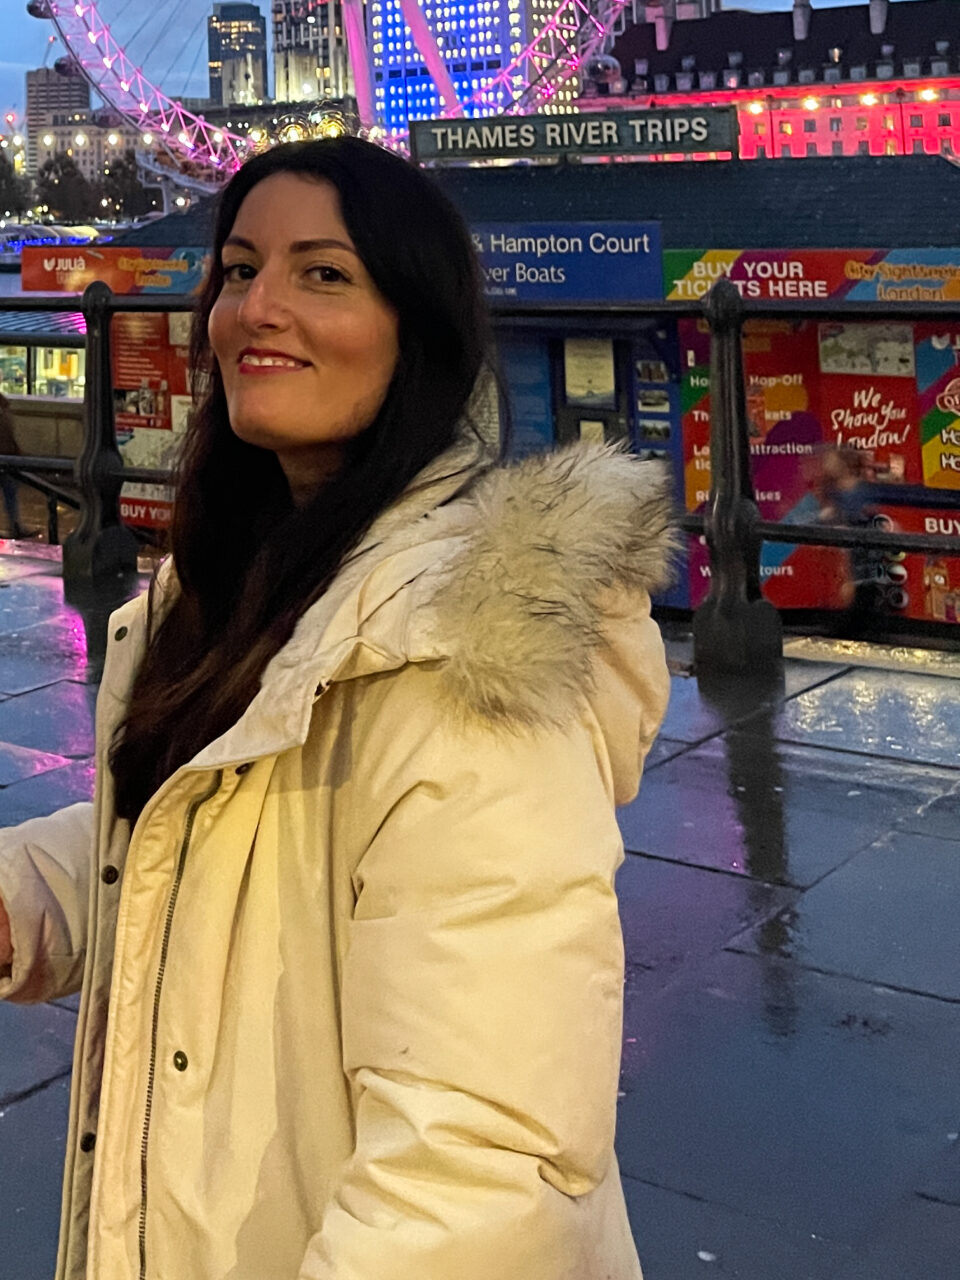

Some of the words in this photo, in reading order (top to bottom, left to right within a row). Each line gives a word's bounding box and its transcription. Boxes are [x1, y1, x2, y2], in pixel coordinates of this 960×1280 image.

[432, 124, 535, 149] THAMES
[546, 121, 618, 147] RIVER
[629, 117, 708, 143] TRIPS
[490, 233, 583, 257] Hampton
[590, 232, 650, 253] Court
[482, 267, 510, 282] ver
[516, 263, 565, 283] Boats
[693, 261, 734, 278] BUY
[743, 261, 804, 278] YOUR
[673, 280, 761, 296] TICTS
[768, 280, 828, 297] HERE
[853, 386, 881, 408] We
[831, 408, 878, 430] Show
[121, 504, 147, 519] BUY
